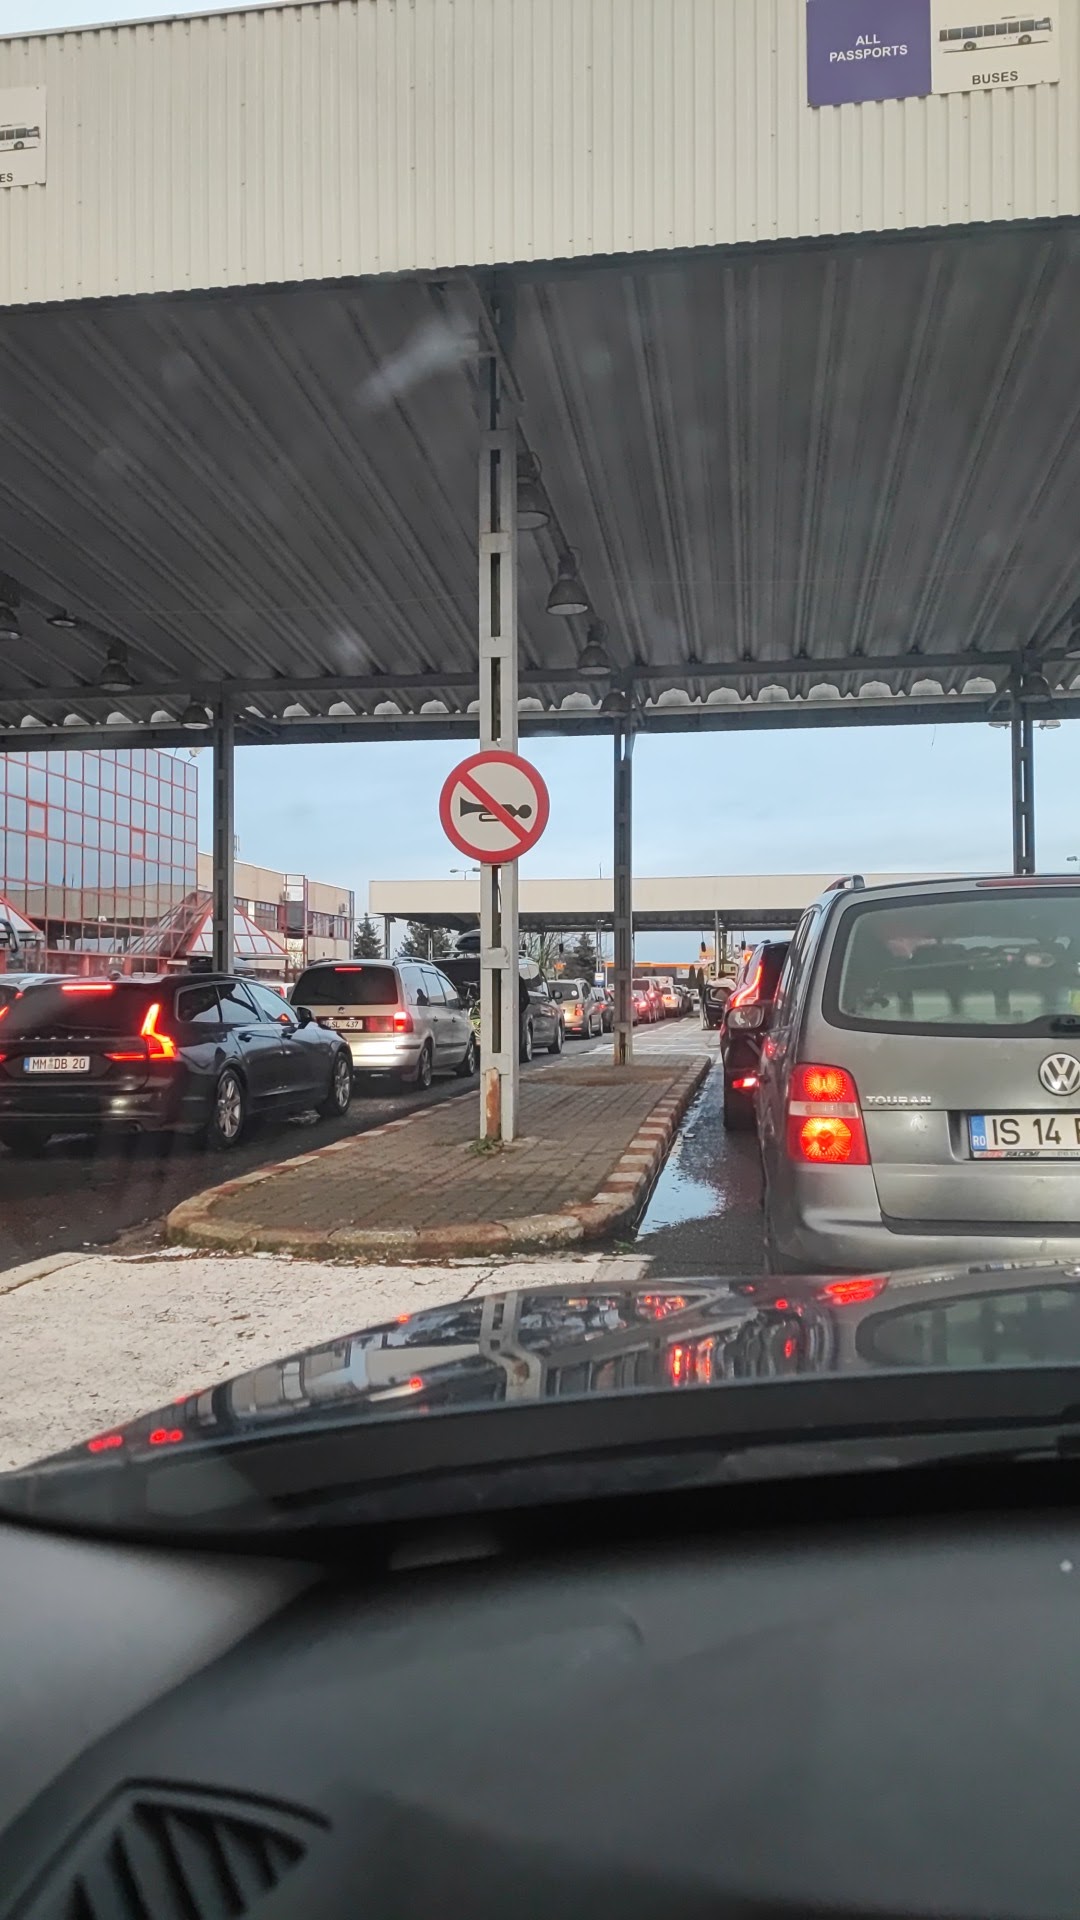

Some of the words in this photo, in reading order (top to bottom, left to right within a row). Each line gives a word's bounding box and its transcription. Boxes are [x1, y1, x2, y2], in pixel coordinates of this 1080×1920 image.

[855, 34, 881, 46] ALL
[829, 44, 908, 62] PASSPORTS
[971, 70, 1019, 85] BUSES
[32, 1058, 47, 1070] MM
[53, 1058, 68, 1069] DB
[72, 1058, 86, 1069] 20
[865, 1095, 932, 1106] TOURAN
[992, 1118, 1021, 1146] IS
[1032, 1117, 1062, 1145] 14
[973, 1135, 986, 1147] RO
